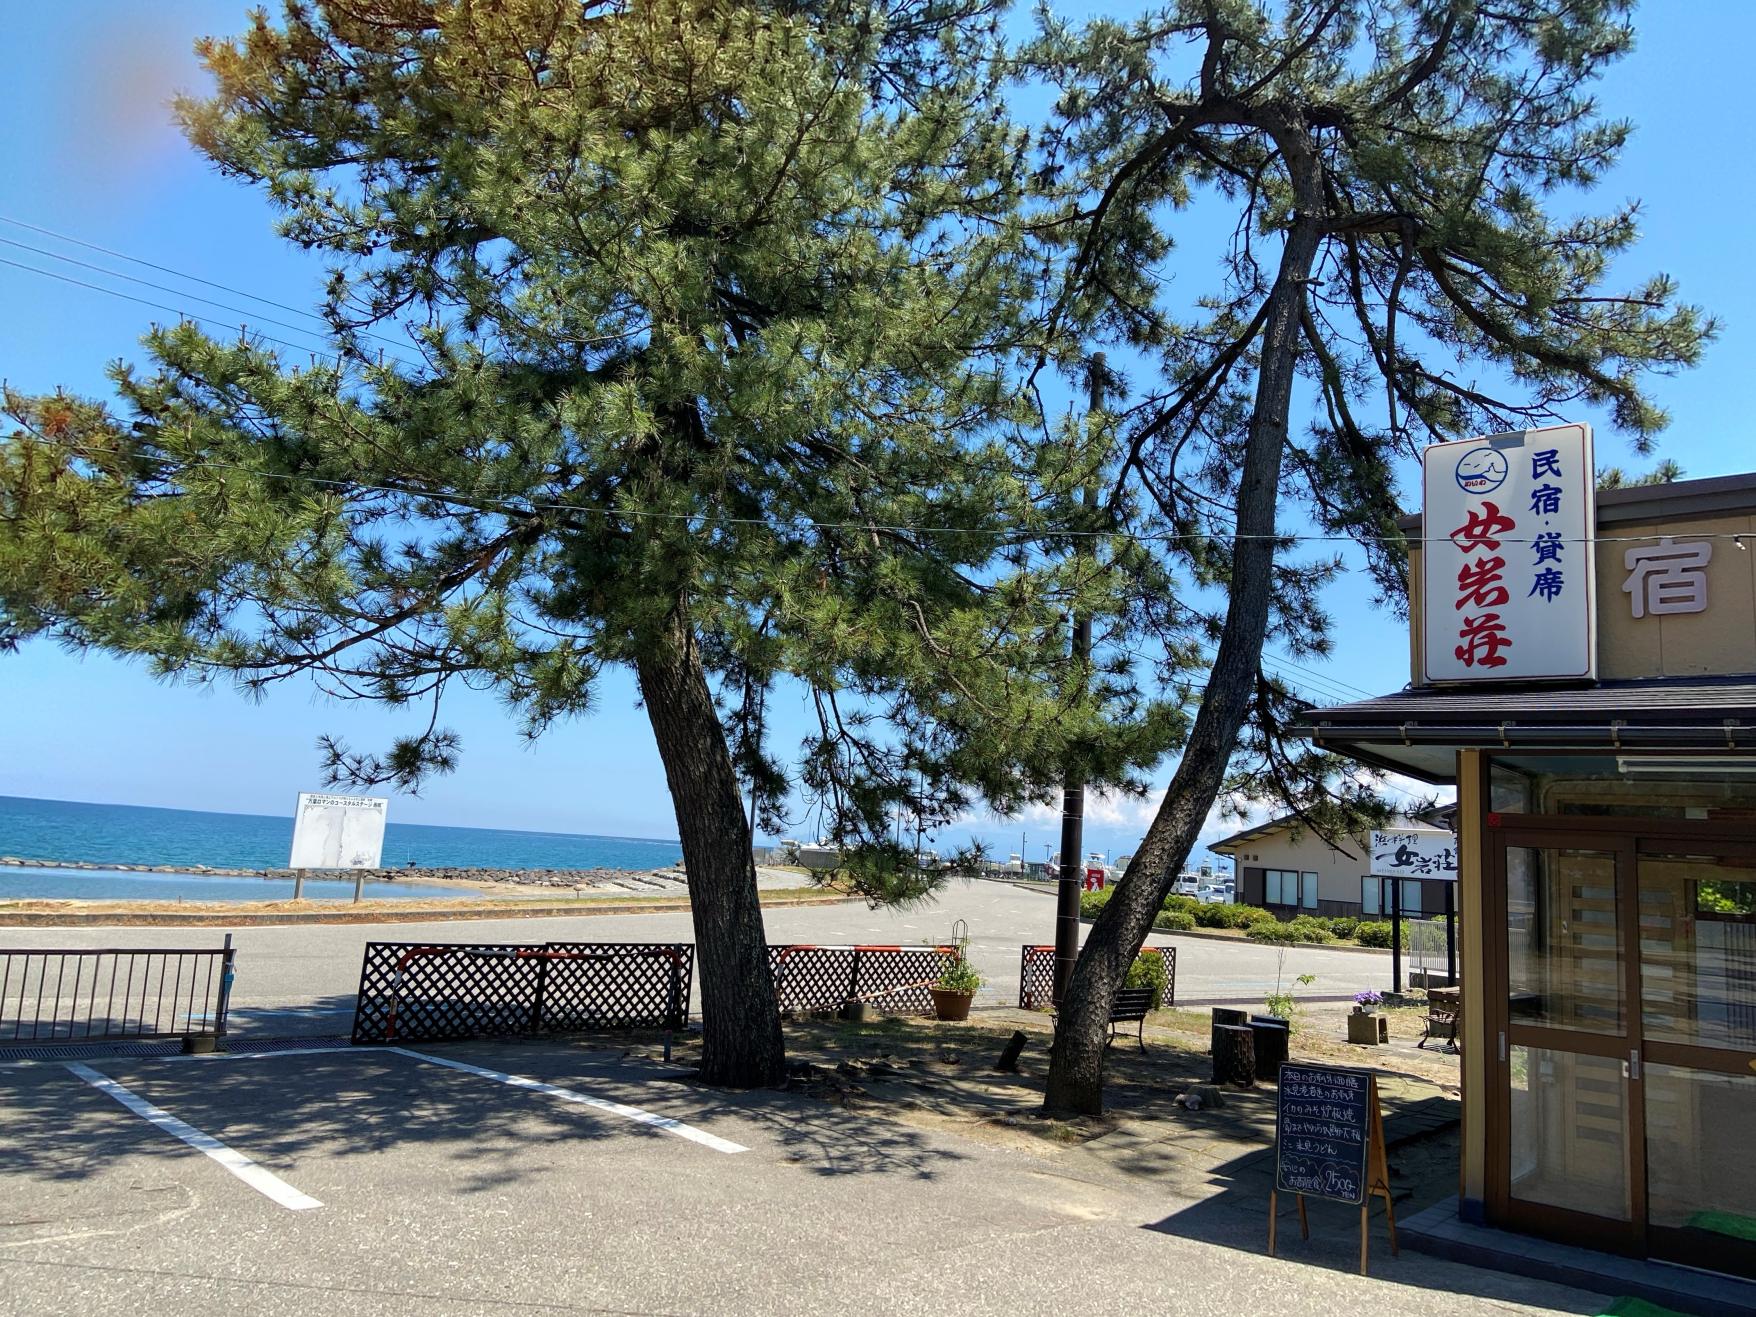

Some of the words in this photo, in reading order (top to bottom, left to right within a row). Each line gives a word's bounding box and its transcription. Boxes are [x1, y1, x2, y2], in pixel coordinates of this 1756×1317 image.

[1450, 501, 1516, 668] 女岩荘
[1622, 537, 1713, 619] 宿
